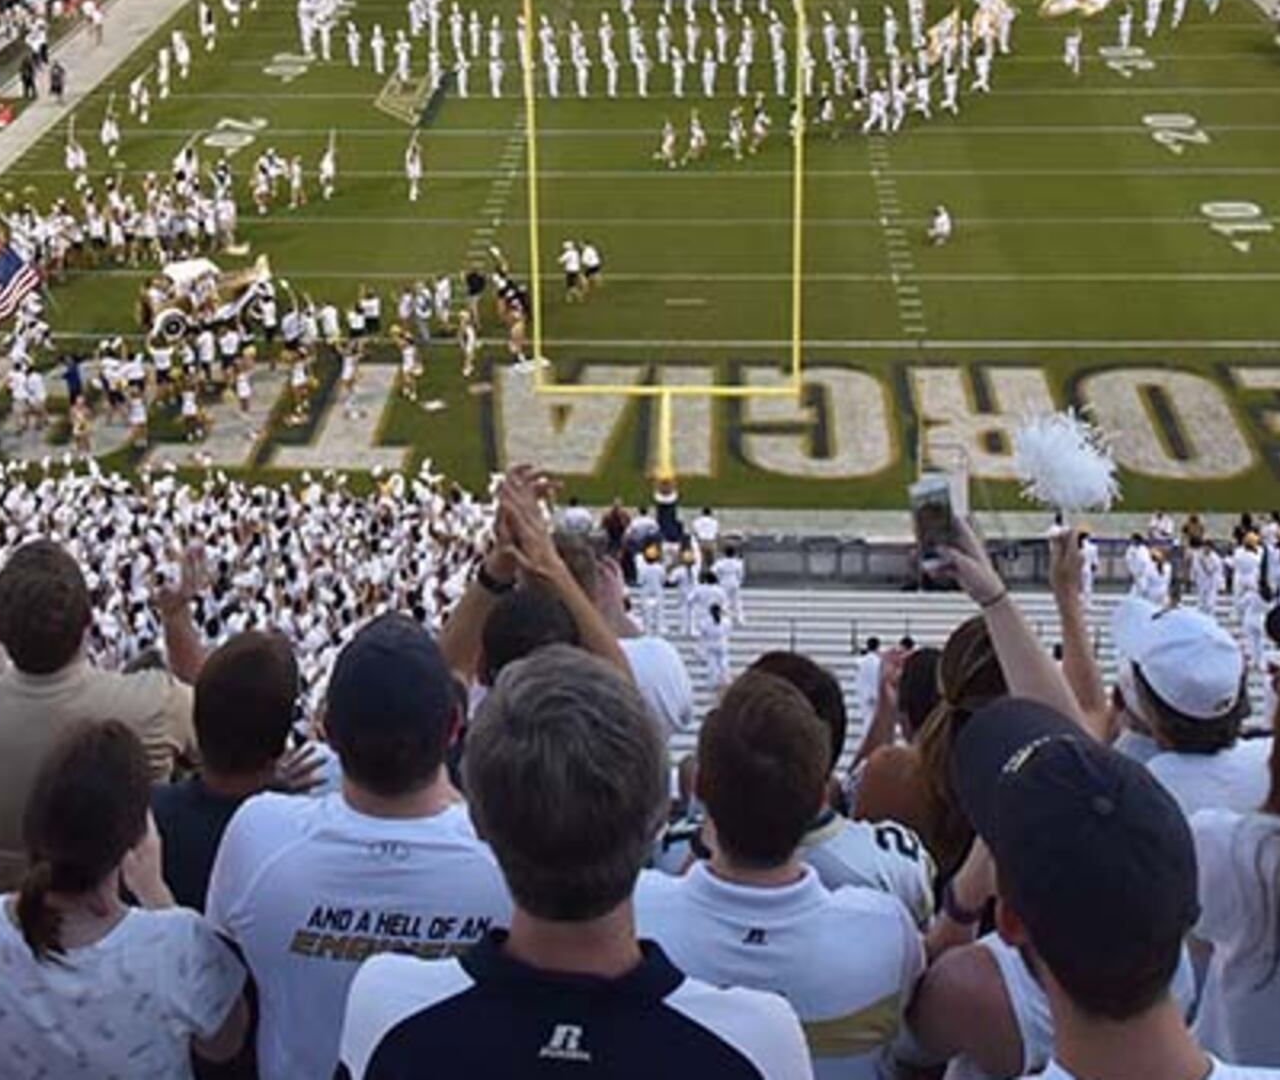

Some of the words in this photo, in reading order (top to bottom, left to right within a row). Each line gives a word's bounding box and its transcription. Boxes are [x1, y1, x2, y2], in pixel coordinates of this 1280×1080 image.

[306, 905, 353, 930] AND
[354, 909, 371, 933] A
[373, 911, 424, 939] HELL
[428, 916, 459, 940] OF
[457, 916, 493, 940] AN
